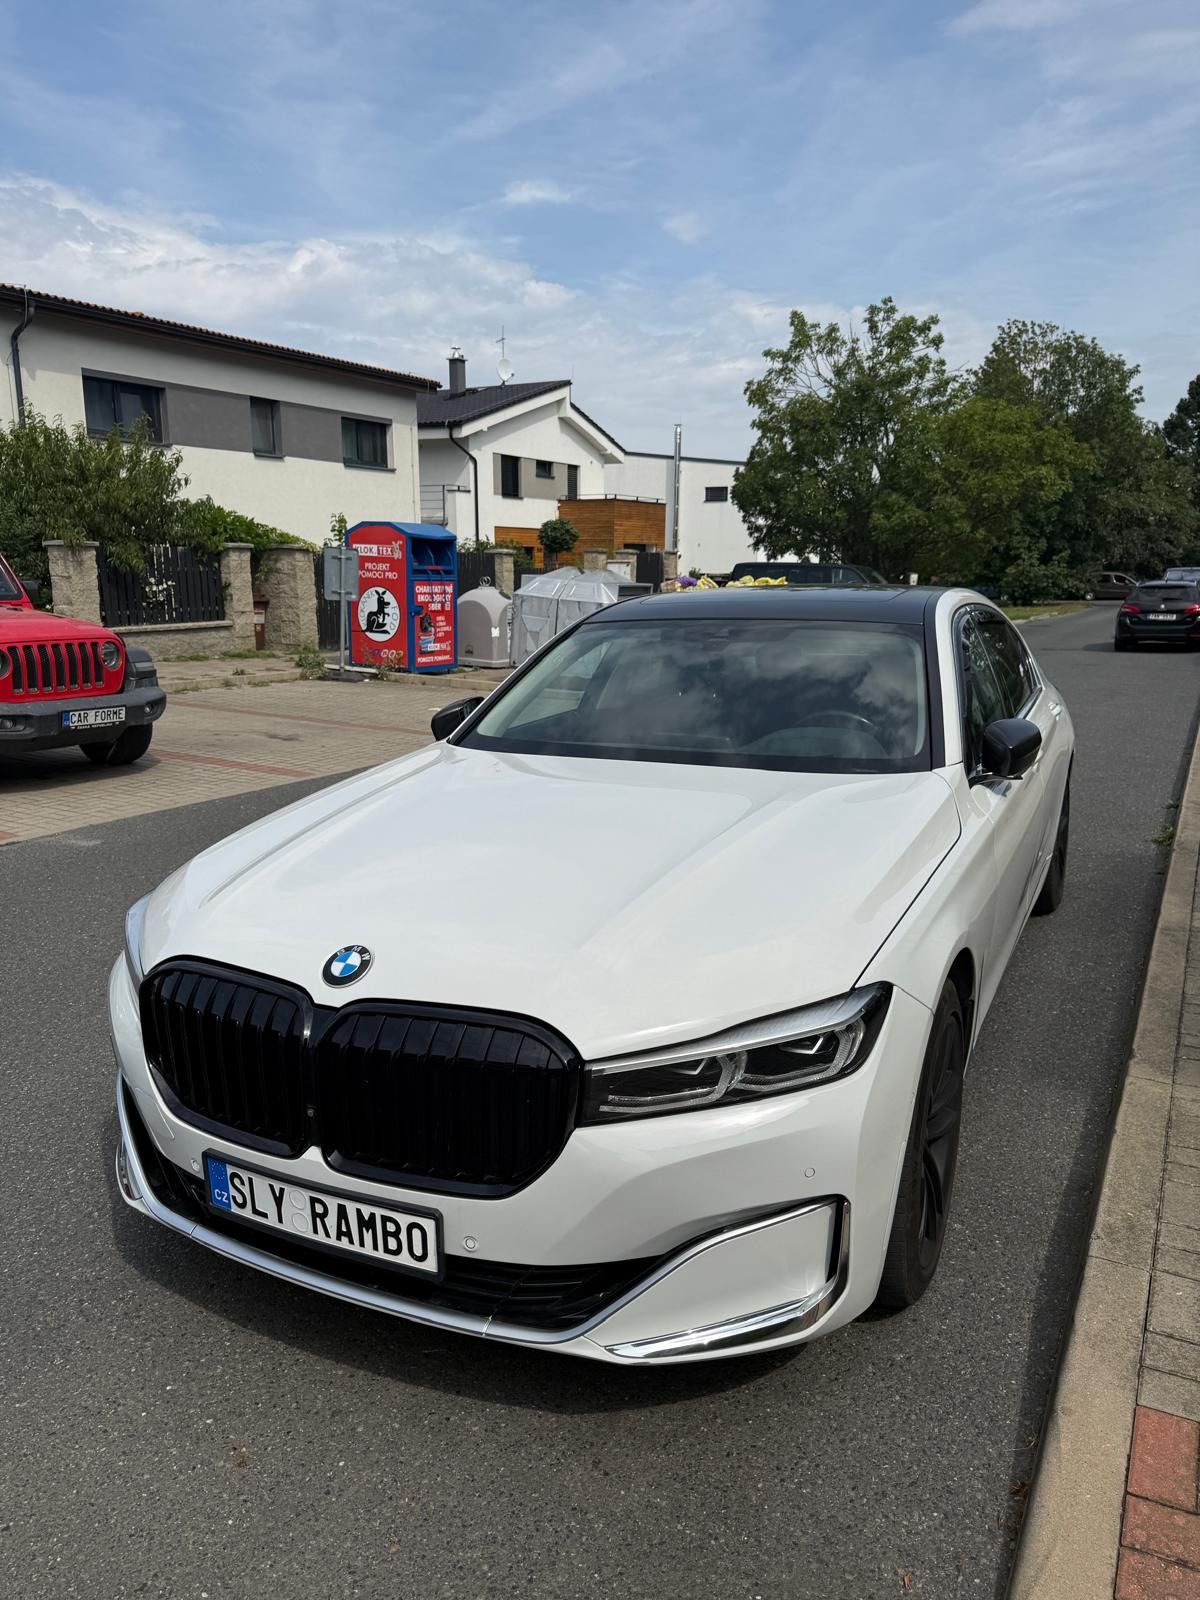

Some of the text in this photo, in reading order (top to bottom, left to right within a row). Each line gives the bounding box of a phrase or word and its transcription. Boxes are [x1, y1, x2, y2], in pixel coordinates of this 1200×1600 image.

[378, 547, 392, 555] TEX
[364, 562, 390, 571] PROJEKT
[384, 571, 398, 580] PRO
[70, 708, 124, 725] CAR FORME
[336, 945, 371, 960] BMW
[214, 1189, 229, 1204] CZ
[229, 1171, 429, 1263] SLY RAMBO
